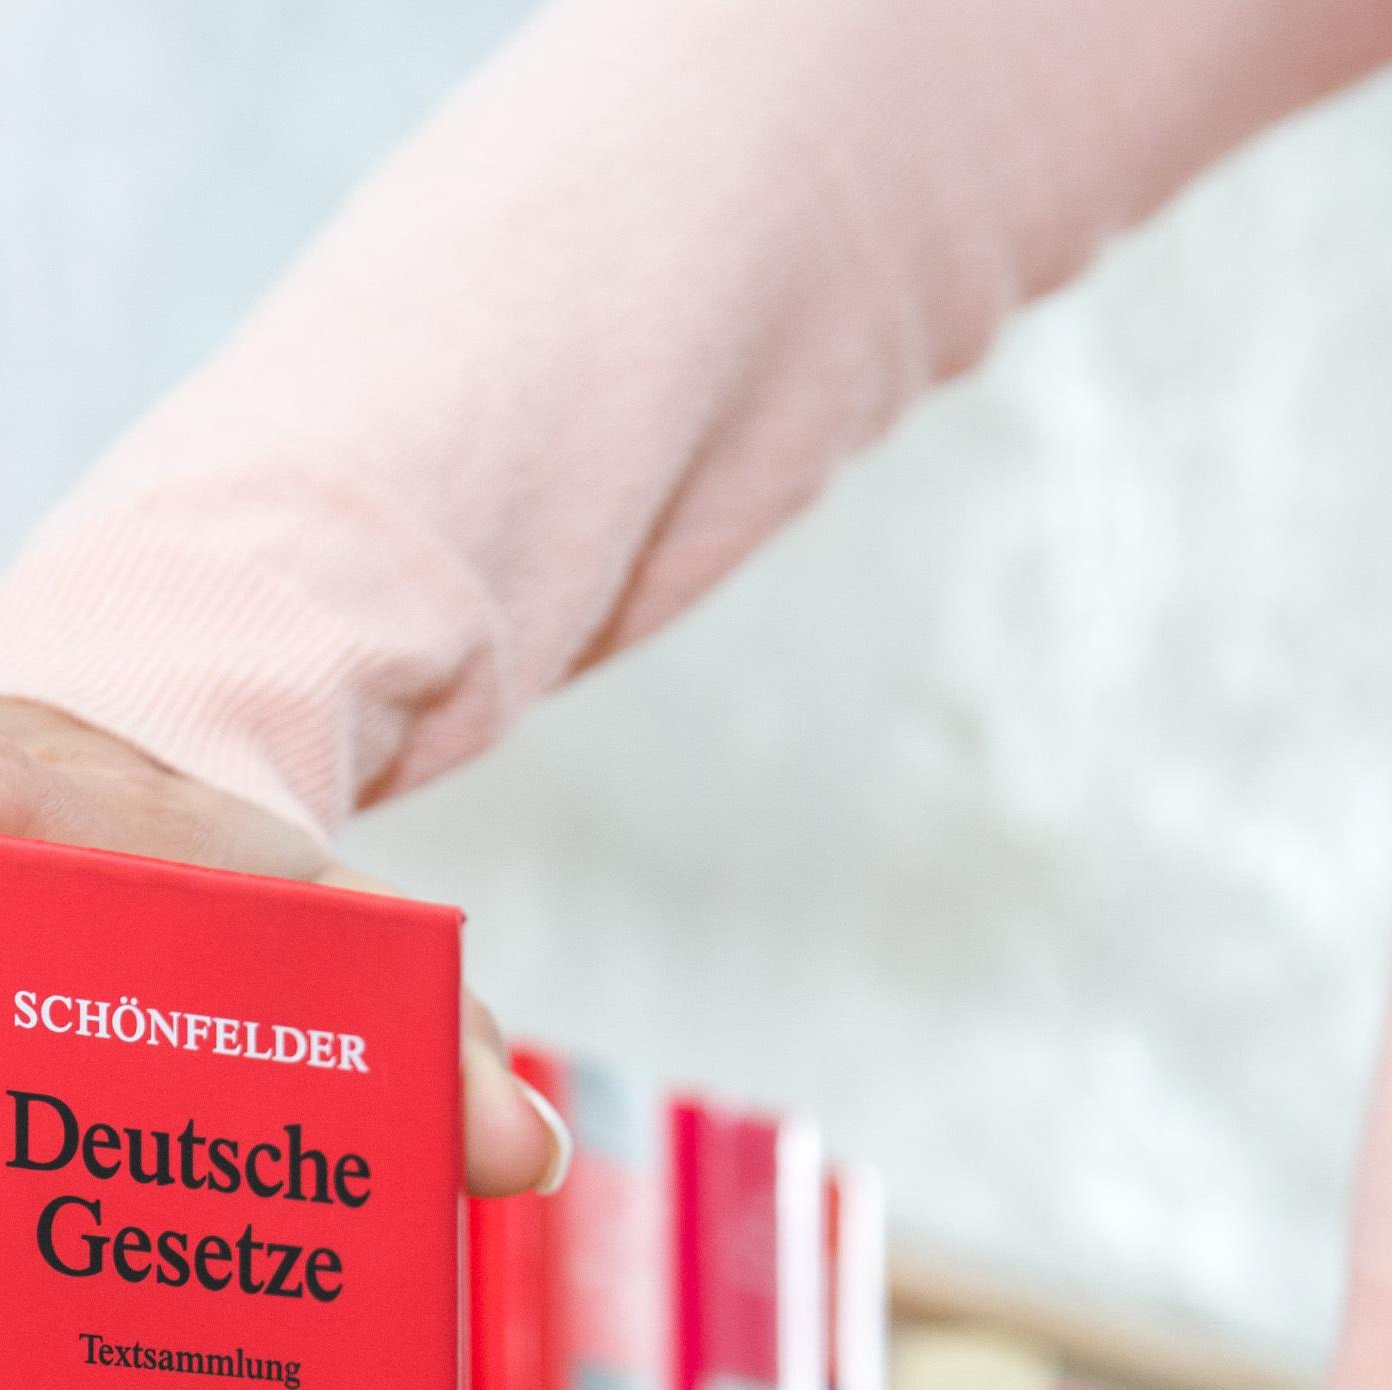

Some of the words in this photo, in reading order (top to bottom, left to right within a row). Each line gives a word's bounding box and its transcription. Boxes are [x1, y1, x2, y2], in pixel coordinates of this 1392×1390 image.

[14, 990, 369, 1073] SCHÖNFELDER
[5, 1089, 372, 1208] Deutsche
[36, 1195, 344, 1303] Gesetze
[78, 1332, 302, 1390] Textsammlung
